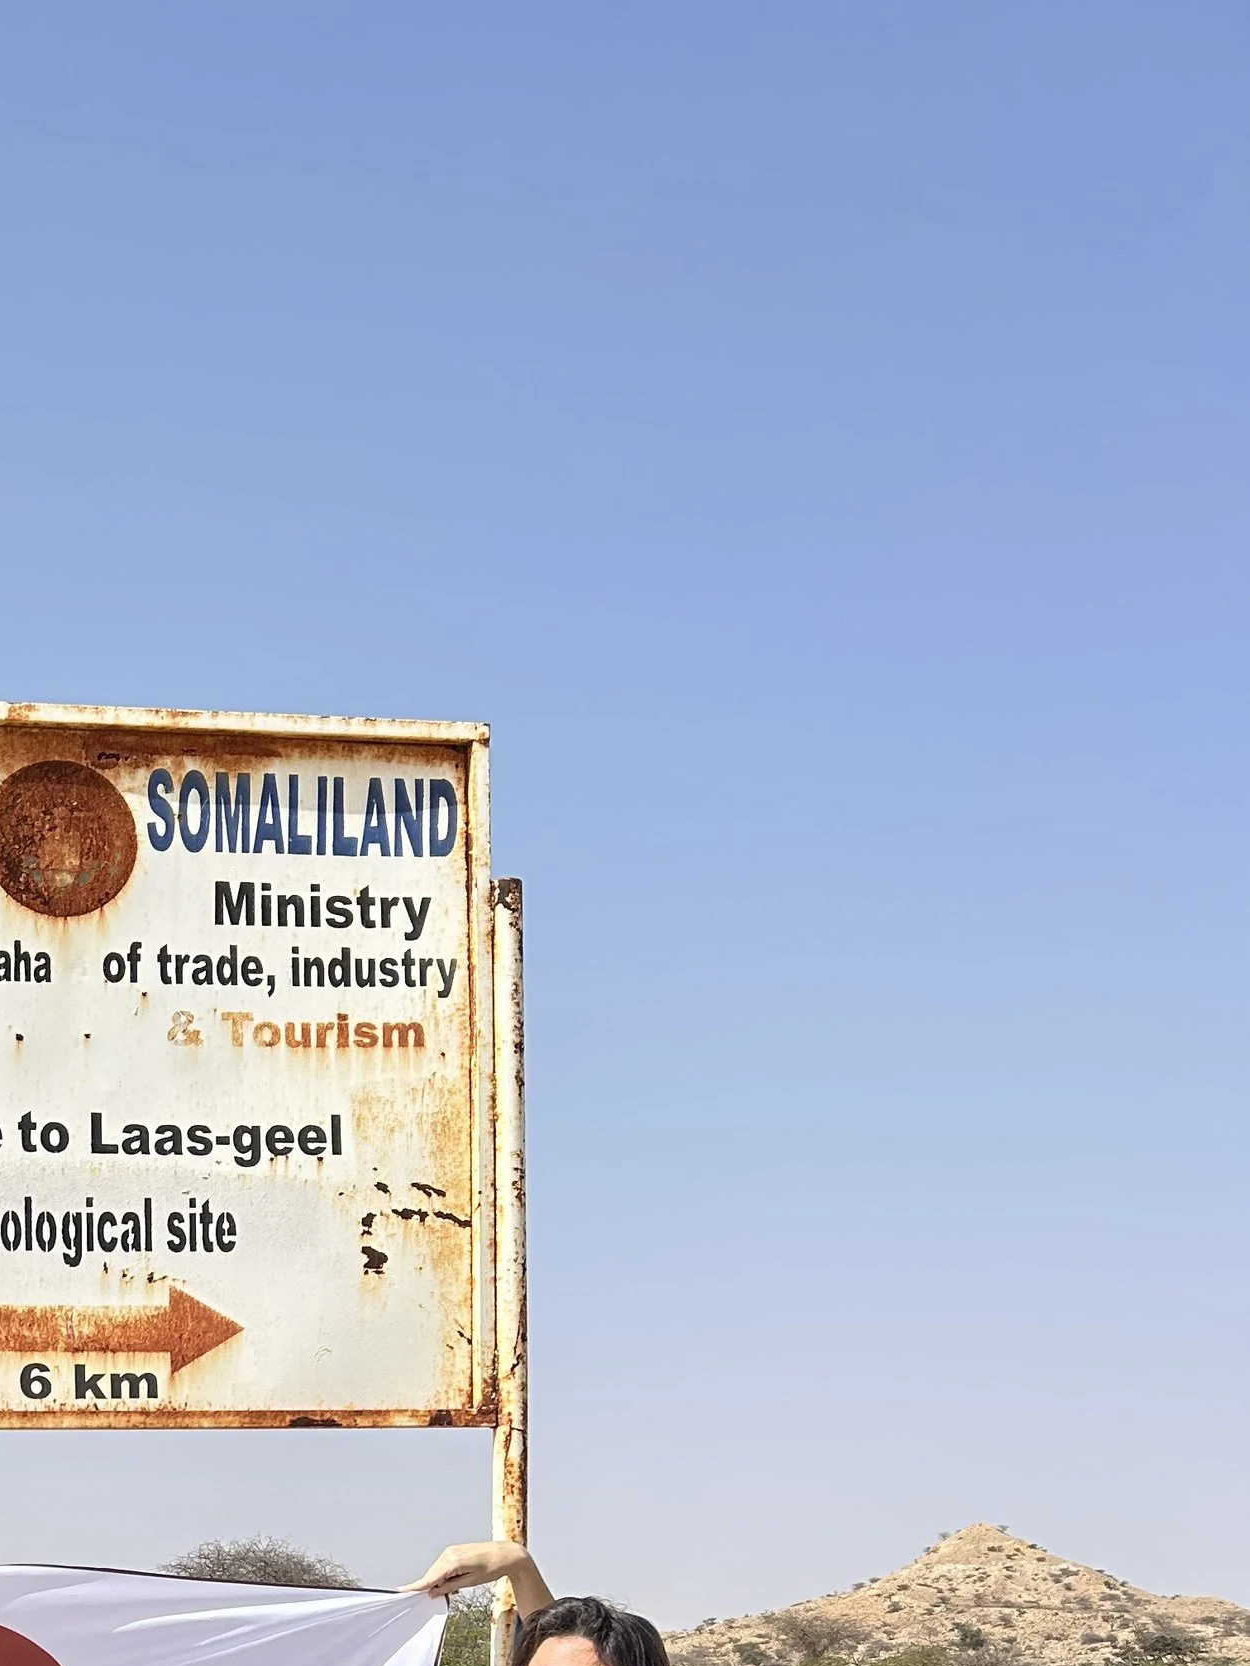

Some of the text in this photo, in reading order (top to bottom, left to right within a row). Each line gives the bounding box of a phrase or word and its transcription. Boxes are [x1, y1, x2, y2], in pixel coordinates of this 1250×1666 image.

[147, 768, 458, 858] SOMALILAND
[213, 880, 433, 942] Ministry
[102, 940, 458, 1000] of trade, industry
[167, 1011, 427, 1050] & Tourism
[17, 1110, 71, 1154] to
[89, 1111, 343, 1168] Laas-geel
[166, 1197, 238, 1254] site
[18, 1362, 159, 1401] 6 km
